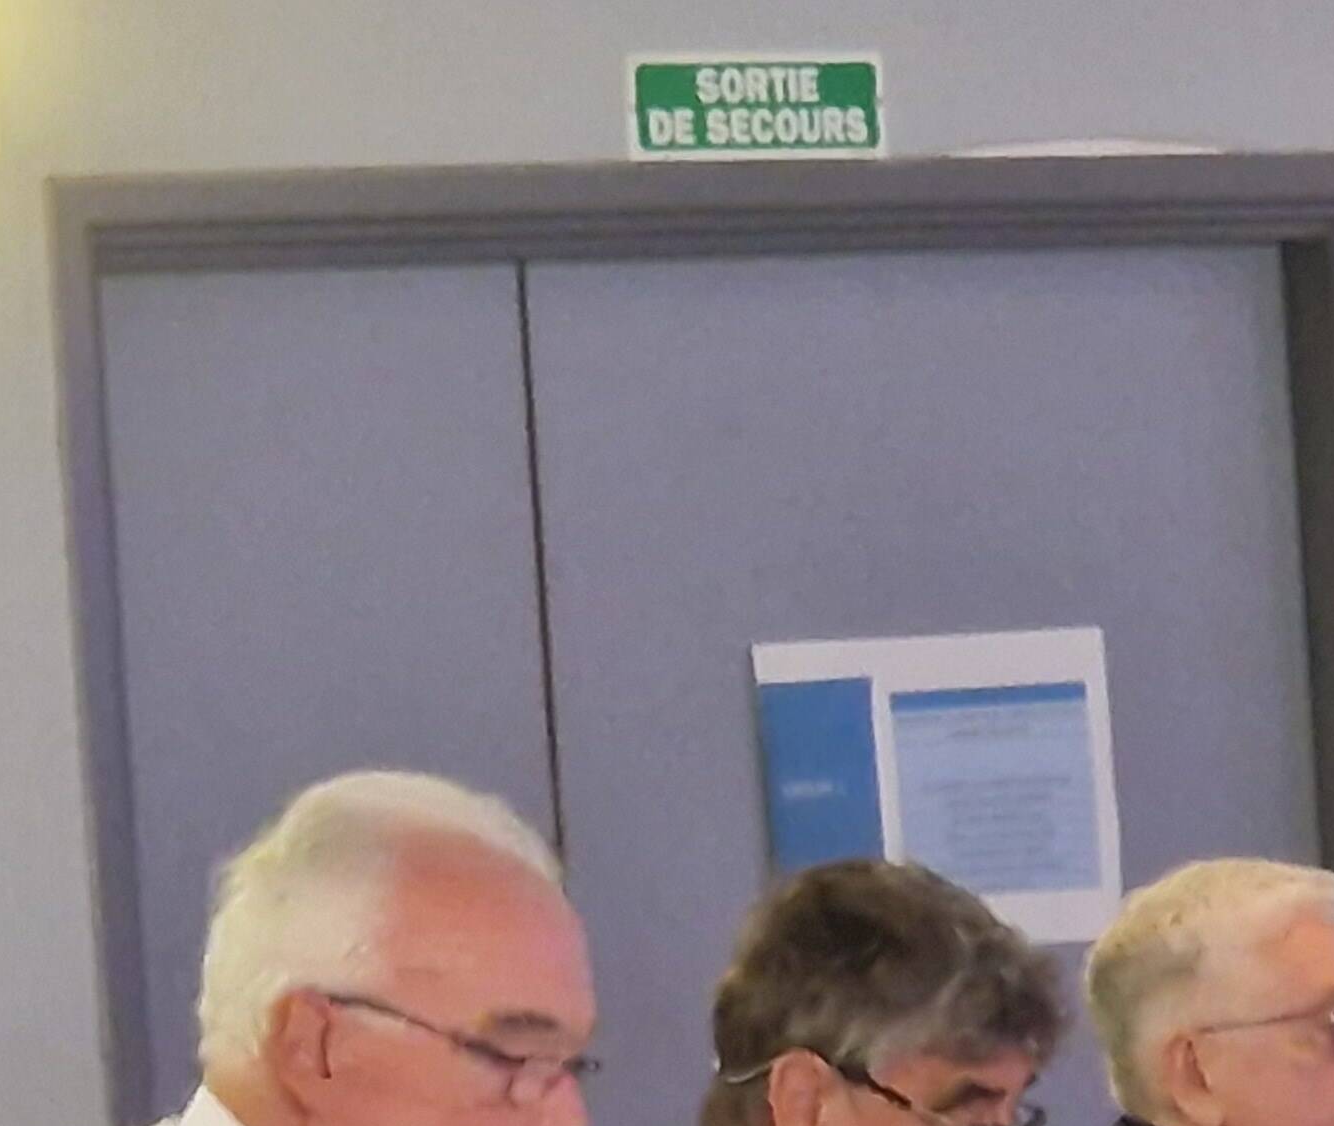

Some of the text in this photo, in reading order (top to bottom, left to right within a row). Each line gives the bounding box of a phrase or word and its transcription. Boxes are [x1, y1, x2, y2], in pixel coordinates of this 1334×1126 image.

[695, 67, 821, 104] SORTIE
[646, 106, 868, 146] DE SECOURS
